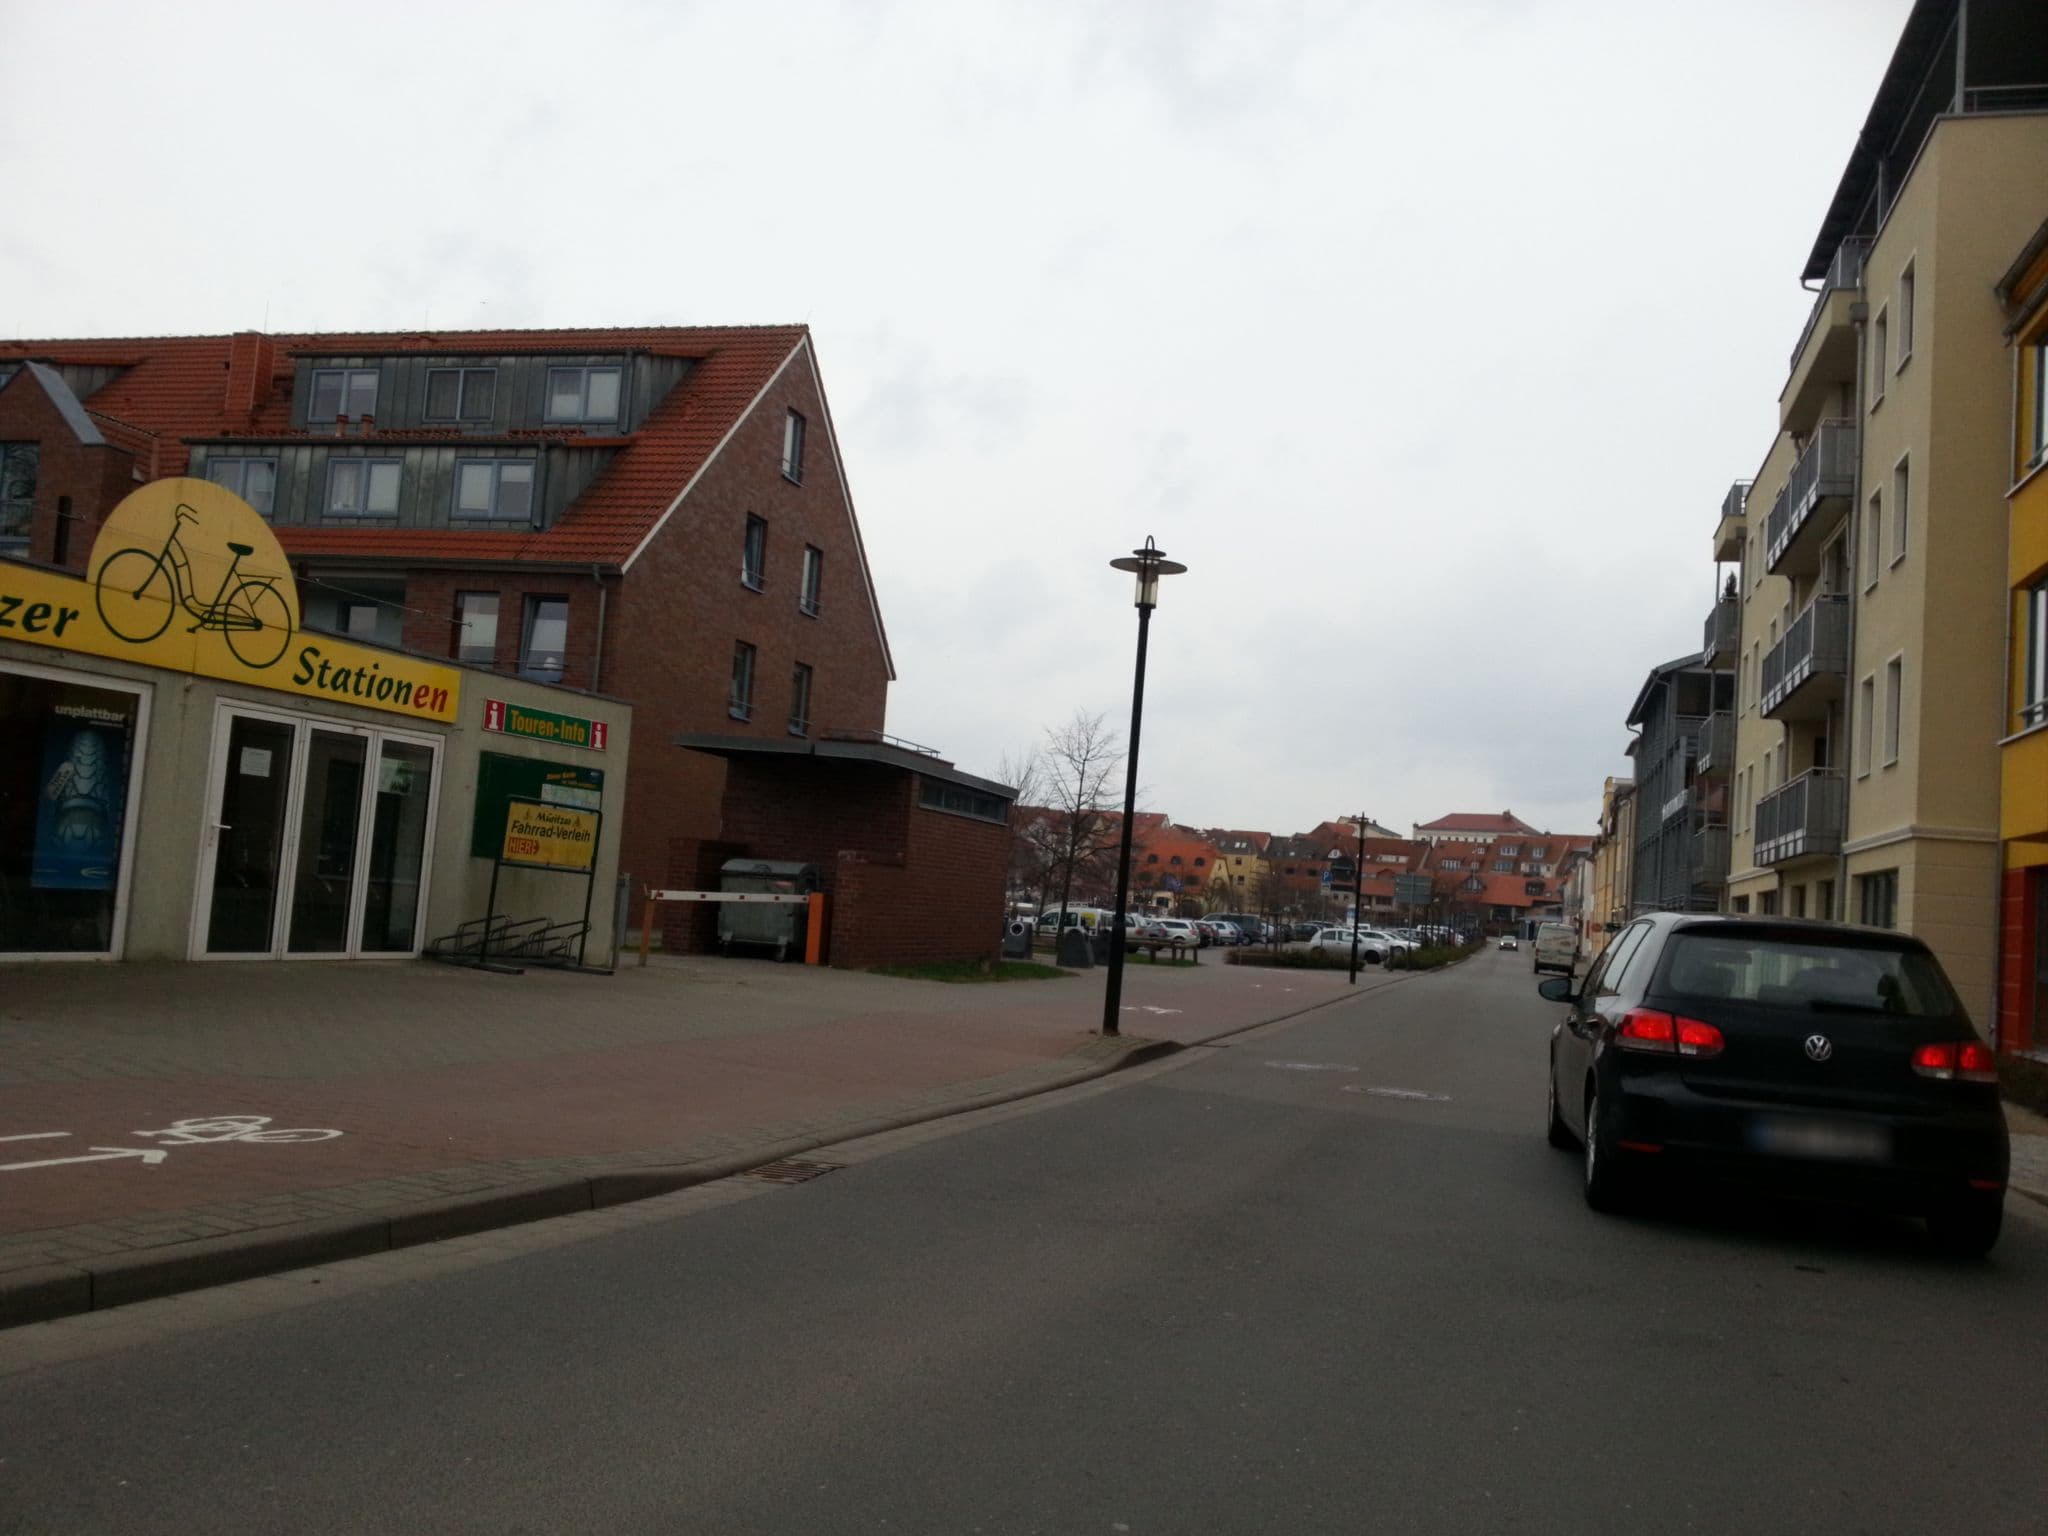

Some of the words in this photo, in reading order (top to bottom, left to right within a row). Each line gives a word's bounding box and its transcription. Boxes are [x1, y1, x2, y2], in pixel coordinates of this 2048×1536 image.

[292, 646, 449, 713] Stationen
[55, 704, 126, 722] unplattbar
[510, 709, 586, 743] Touren-Info
[511, 820, 591, 843] Fahrrad-Verleih
